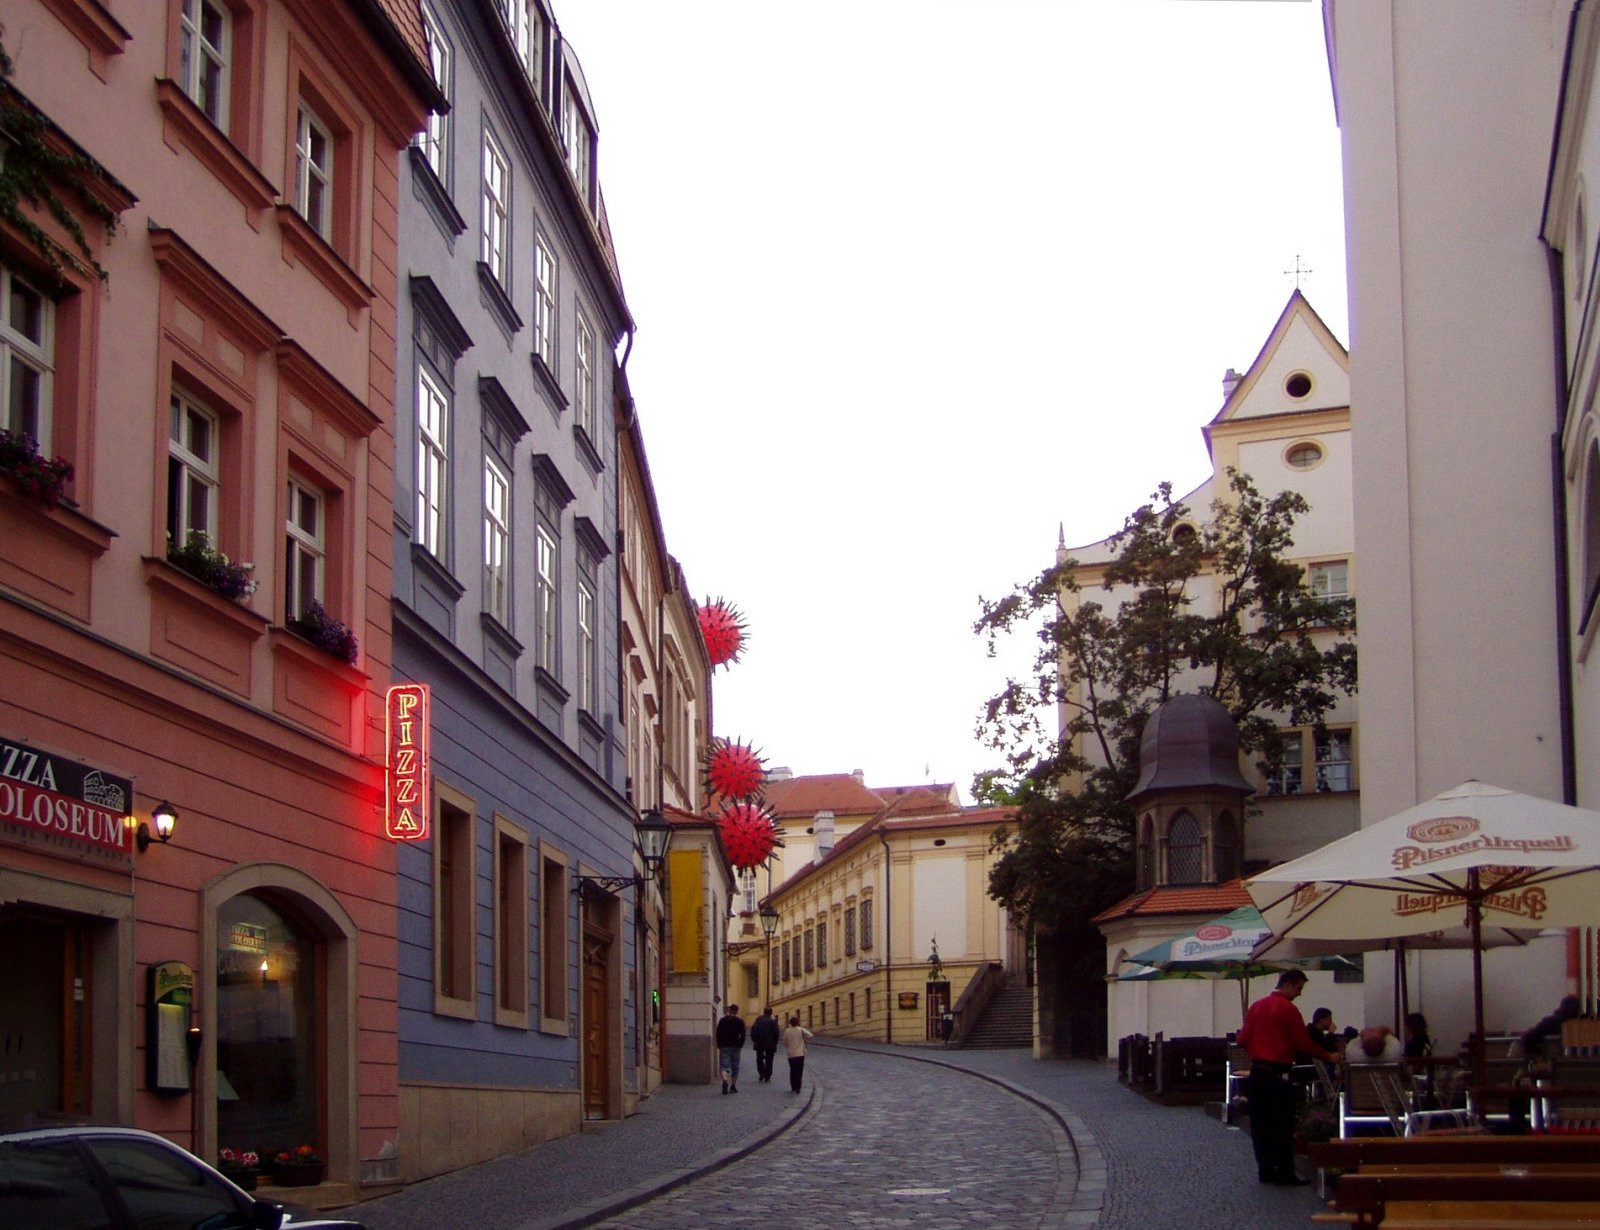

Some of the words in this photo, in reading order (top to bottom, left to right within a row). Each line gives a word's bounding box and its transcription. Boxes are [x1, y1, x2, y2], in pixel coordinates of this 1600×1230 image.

[0, 743, 58, 792] ZZA
[394, 693, 418, 831] PIZZA
[1391, 840, 1481, 870] Pilsner
[1479, 834, 1573, 853] Urquell
